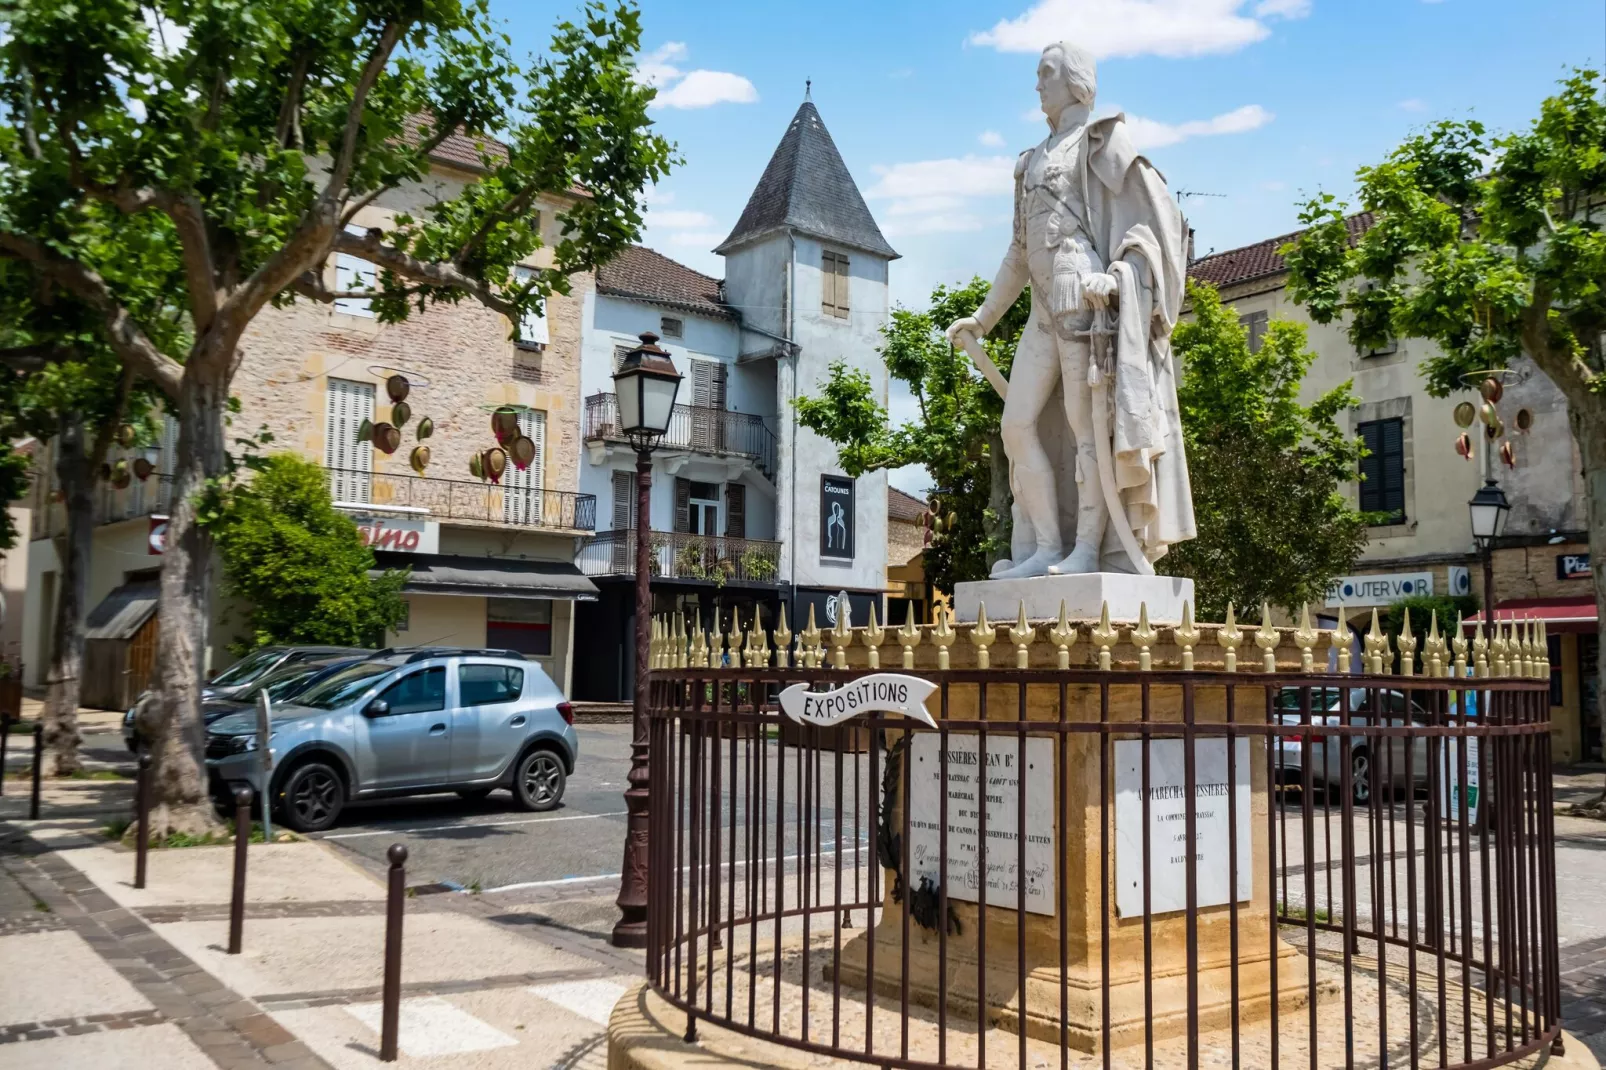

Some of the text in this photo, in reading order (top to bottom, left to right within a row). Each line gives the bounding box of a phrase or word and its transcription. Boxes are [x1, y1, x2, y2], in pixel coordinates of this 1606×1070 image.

[357, 521, 420, 550] sino
[1392, 578, 1428, 597] VOIR
[984, 752, 1001, 767] EAN
[1149, 781, 1186, 801] MARÉCHA
[1195, 810, 1215, 820] RAYSSAC
[948, 824, 955, 833] DE
[956, 825, 973, 836] CANON
